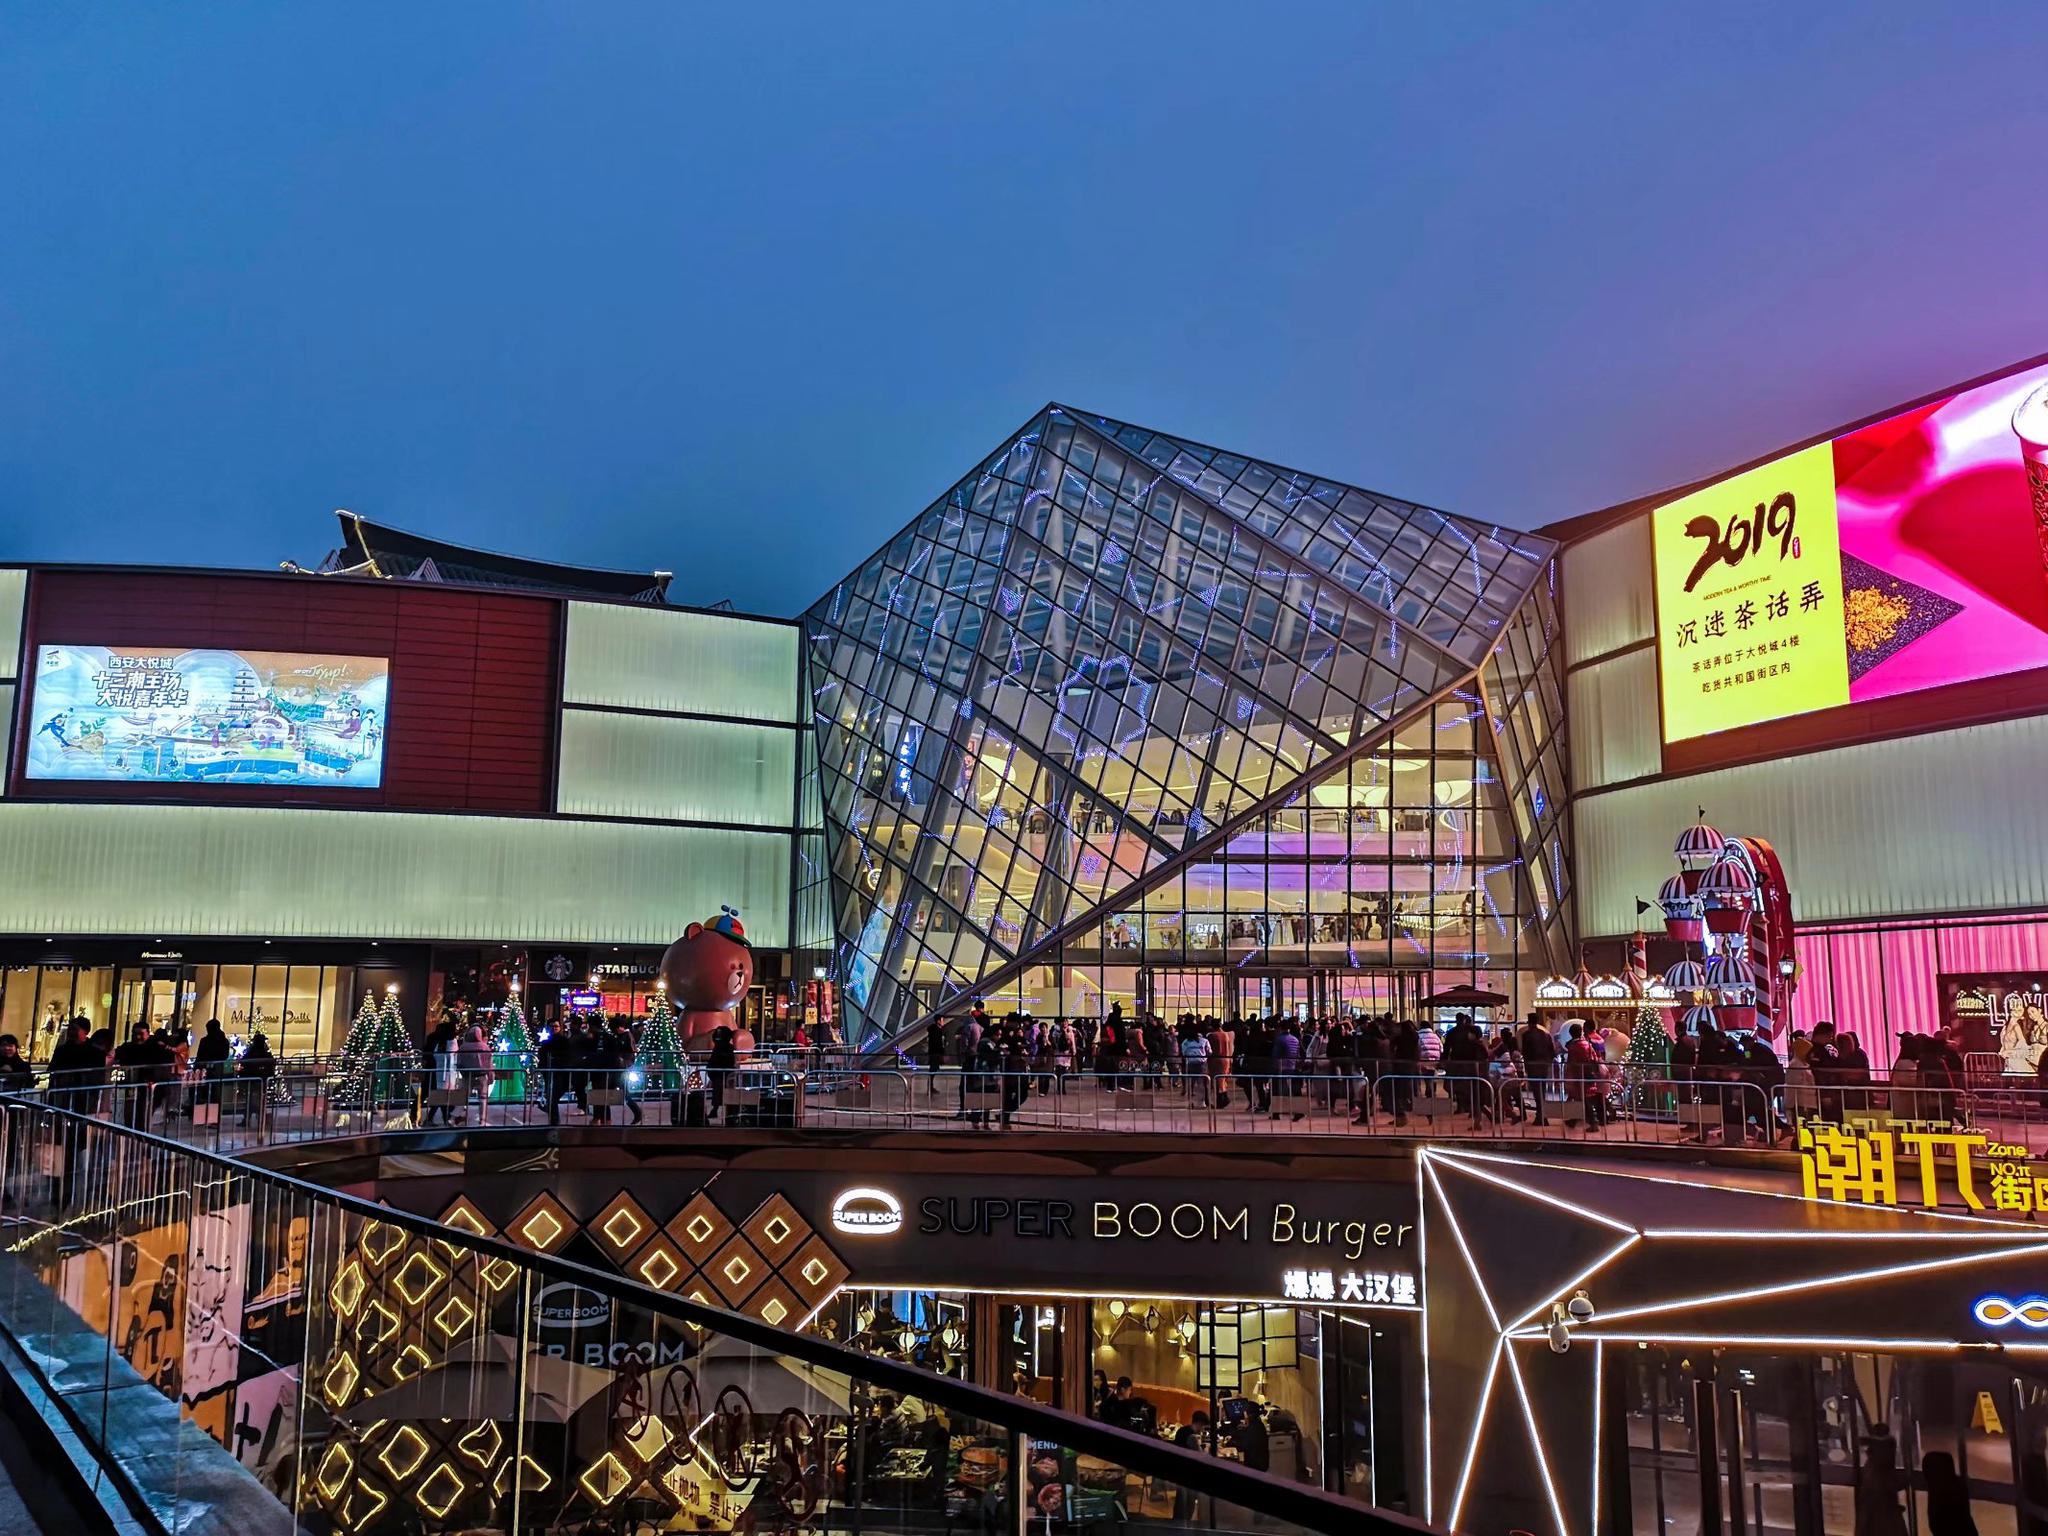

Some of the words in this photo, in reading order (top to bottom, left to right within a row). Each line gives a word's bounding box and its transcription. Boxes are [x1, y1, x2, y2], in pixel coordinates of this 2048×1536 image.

[1683, 491, 1796, 593] 2019
[1677, 580, 1825, 648] 沉迷茶话弄
[109, 656, 174, 670] 西安大悦城
[1692, 635, 1800, 673] 茶话弄位于大悦城4楼
[1702, 662, 1791, 693] 吃货共和国街区内
[95, 689, 189, 708] 大悦嘉年华
[1988, 993, 2048, 1027] LOV
[1987, 1142, 2027, 1157] Zone
[832, 1210, 868, 1223] SUPER
[868, 1209, 902, 1224] BOOM
[920, 1198, 1074, 1238] SUPER
[1093, 1201, 1249, 1241] BOOM
[1272, 1203, 1414, 1260] Burger
[532, 1305, 572, 1319] SUPER
[572, 1304, 609, 1318] BOOM
[1028, 1440, 1058, 1450] MENU
